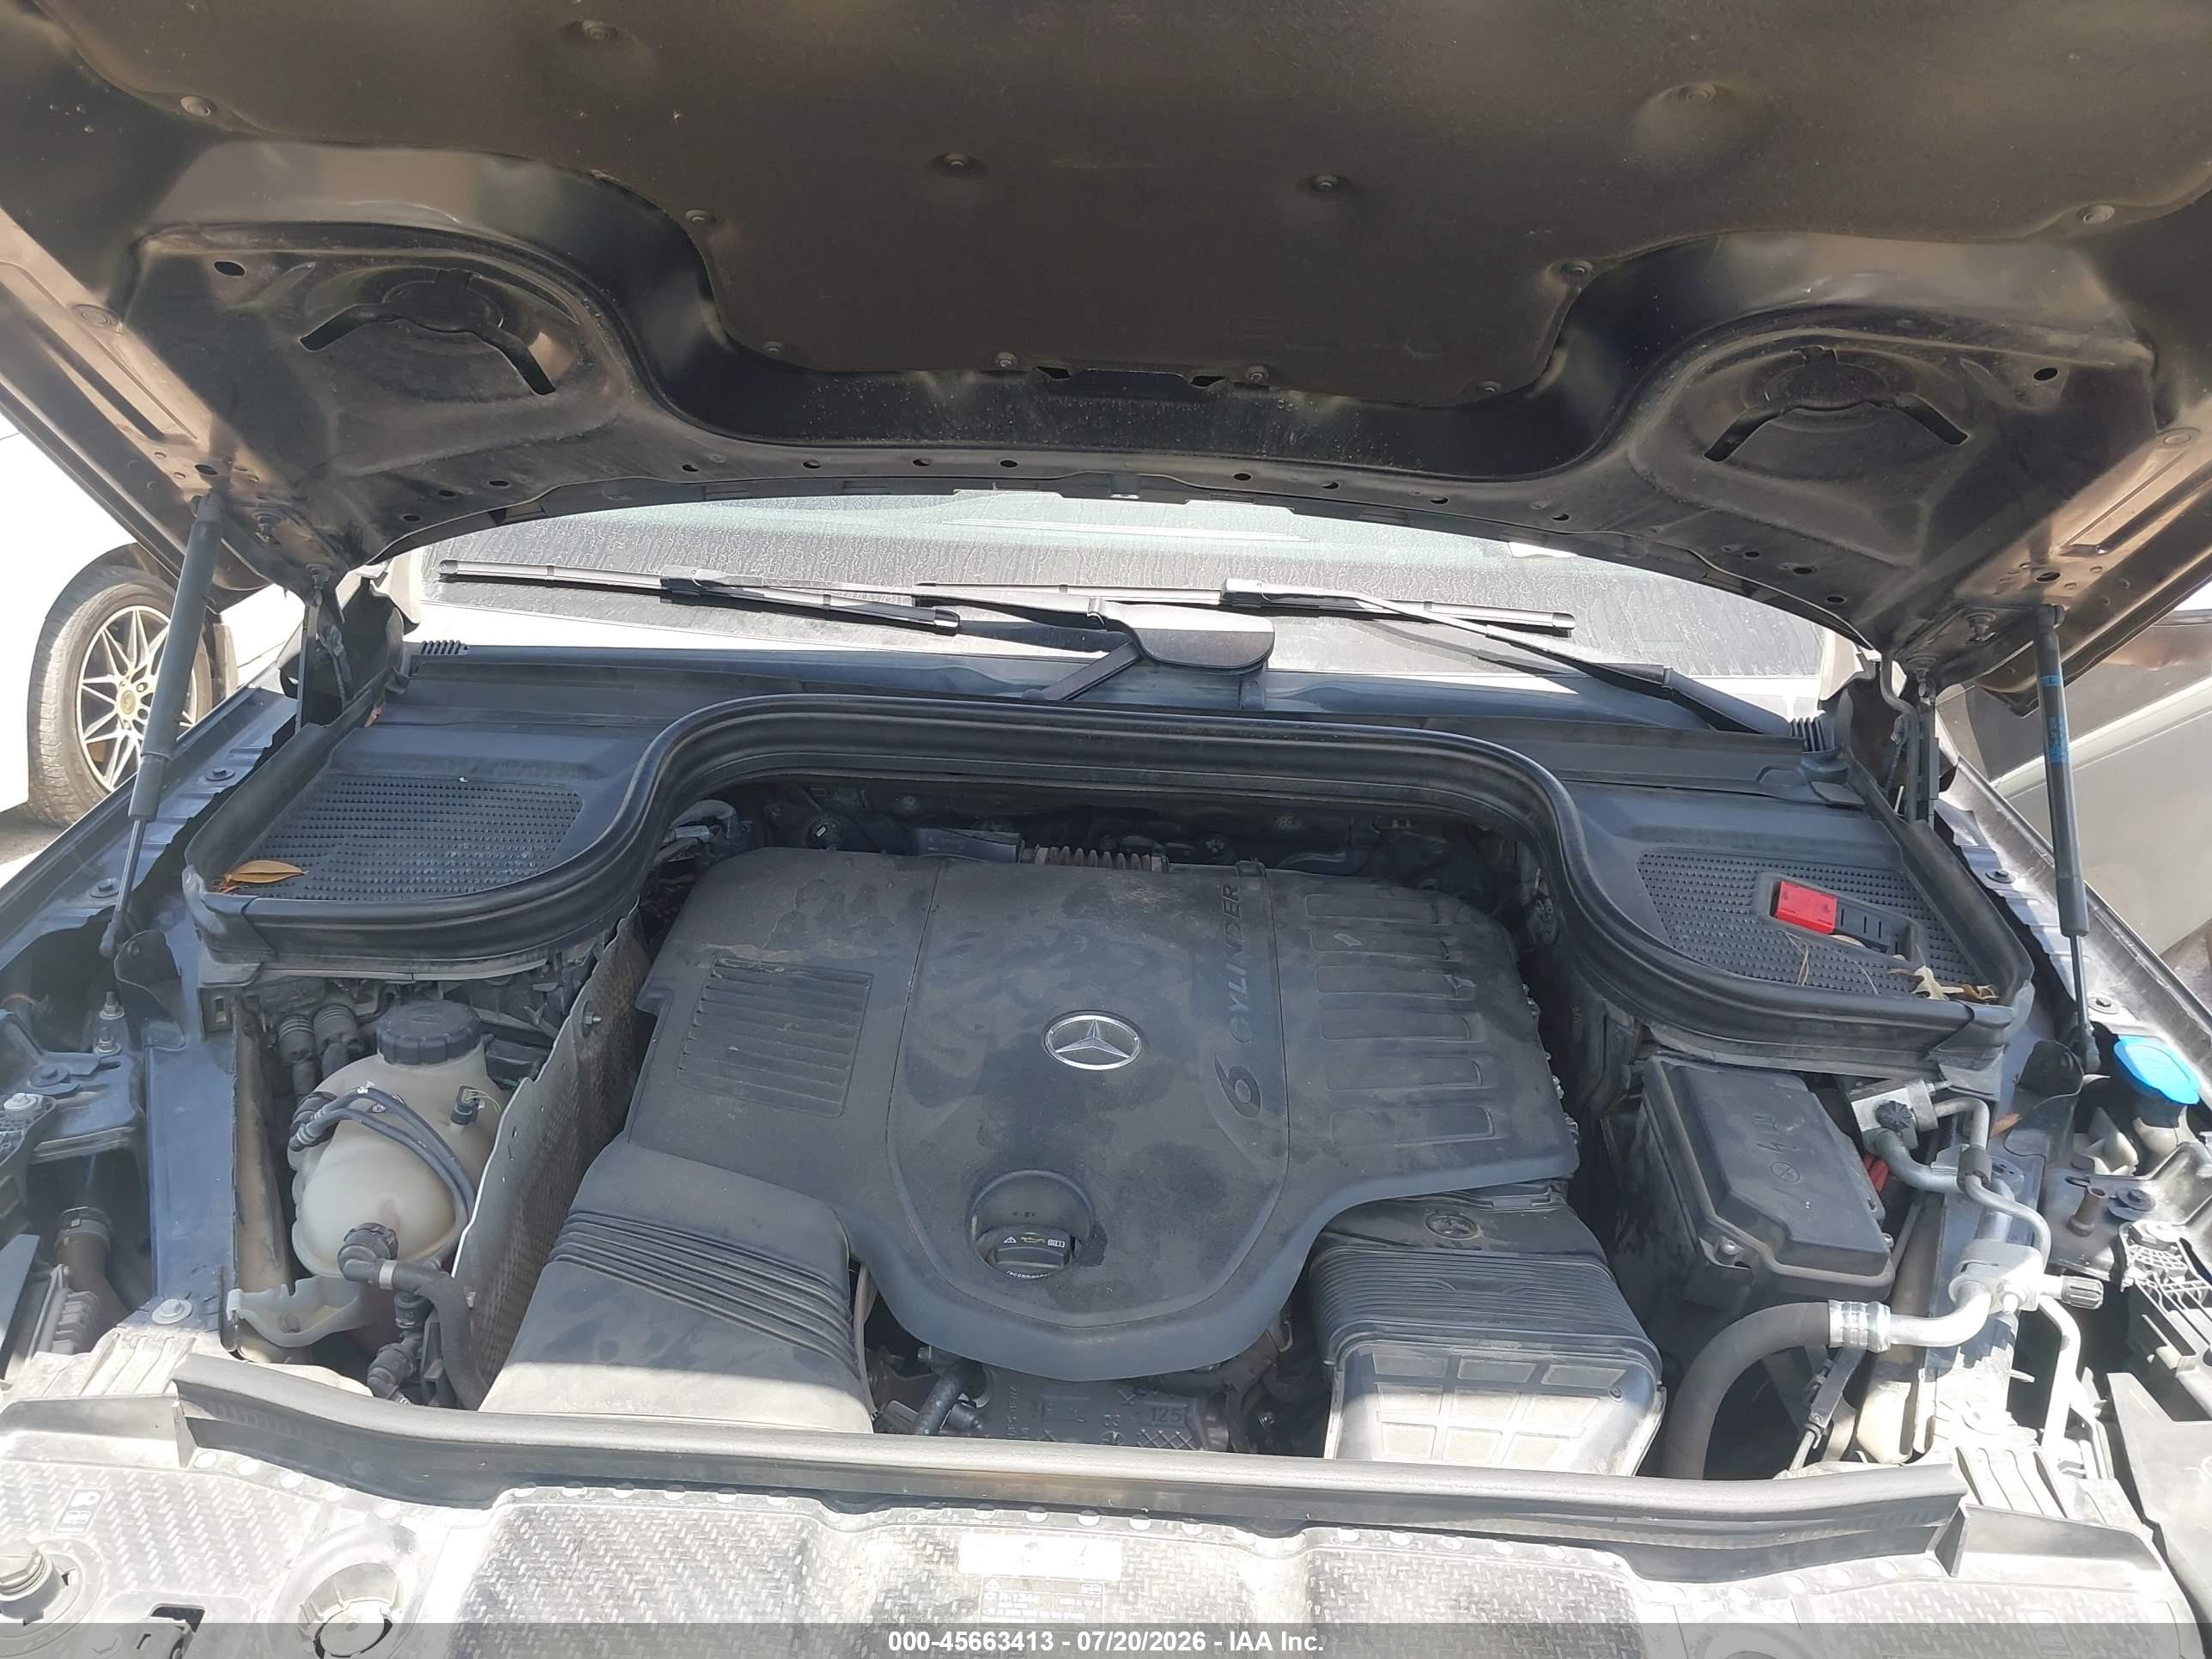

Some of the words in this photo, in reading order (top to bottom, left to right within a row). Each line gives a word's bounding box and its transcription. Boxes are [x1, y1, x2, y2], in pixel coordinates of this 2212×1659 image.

[1222, 883, 1252, 1045] CYLINDER
[1213, 1053, 1262, 1119] 6
[1151, 1407, 1182, 1423] 125
